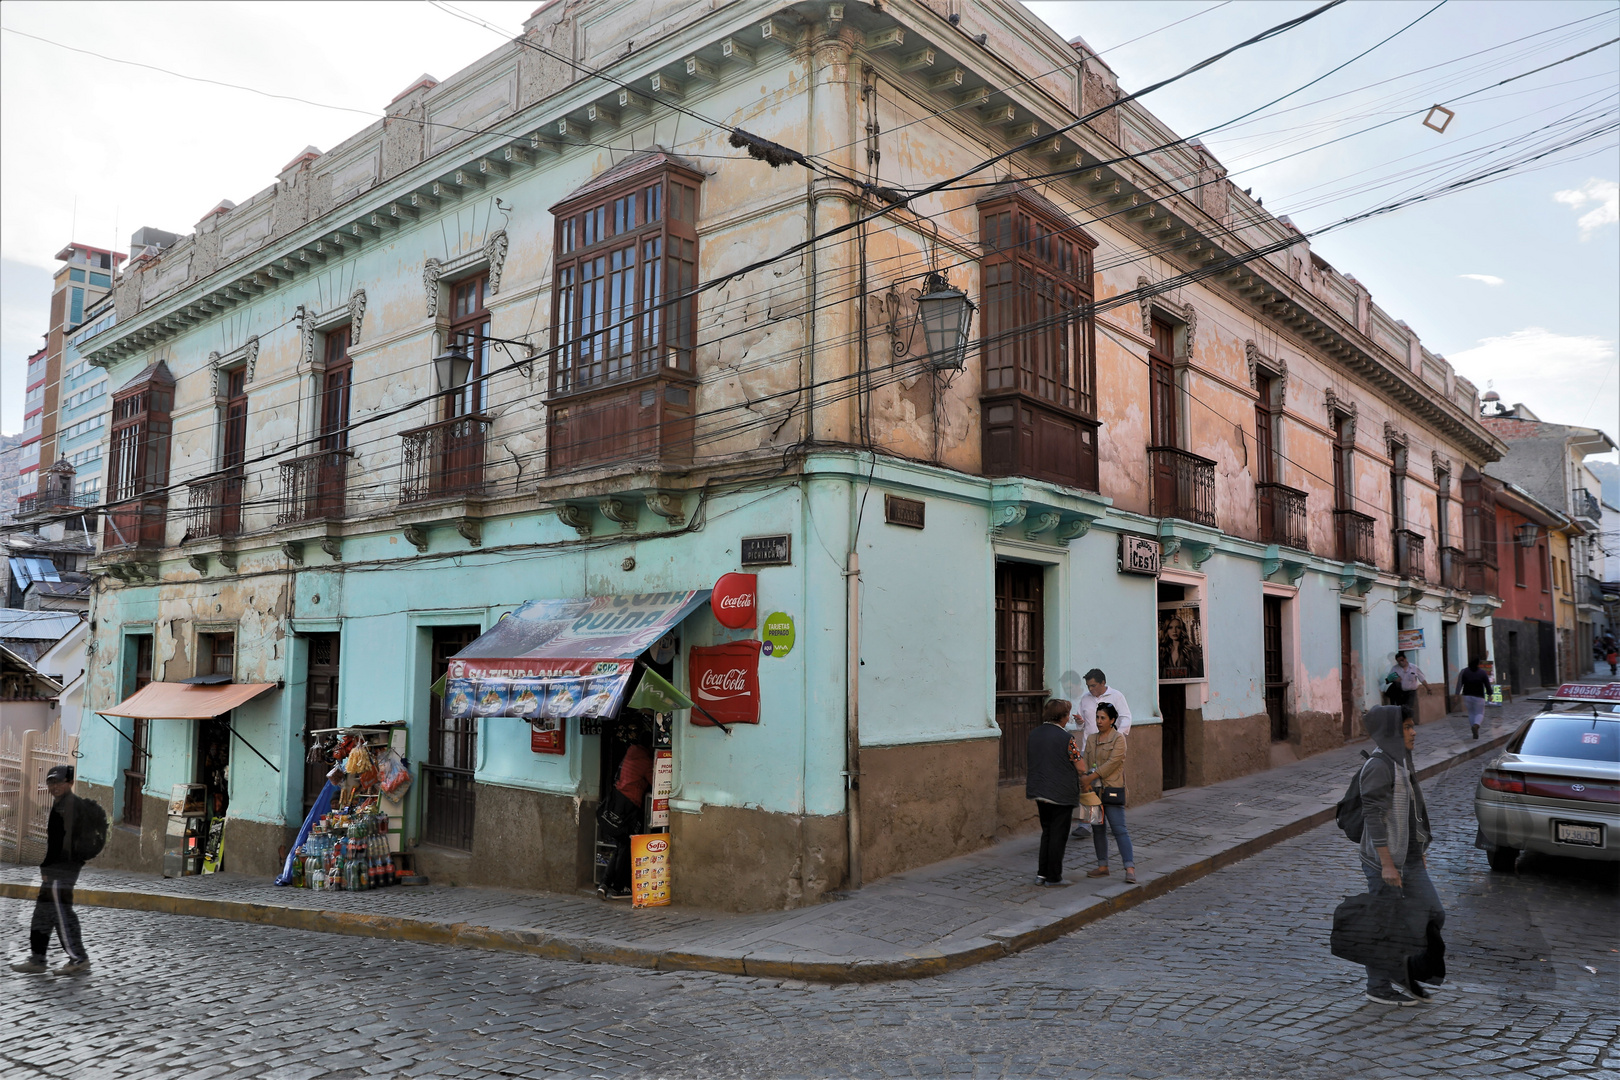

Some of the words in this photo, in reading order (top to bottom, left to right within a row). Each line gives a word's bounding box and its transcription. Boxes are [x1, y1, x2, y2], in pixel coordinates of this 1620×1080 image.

[751, 541, 776, 549] CALLE
[1133, 550, 1155, 570] CESY
[720, 593, 752, 609] Coca-Cola
[701, 669, 748, 691] Coca-Cola
